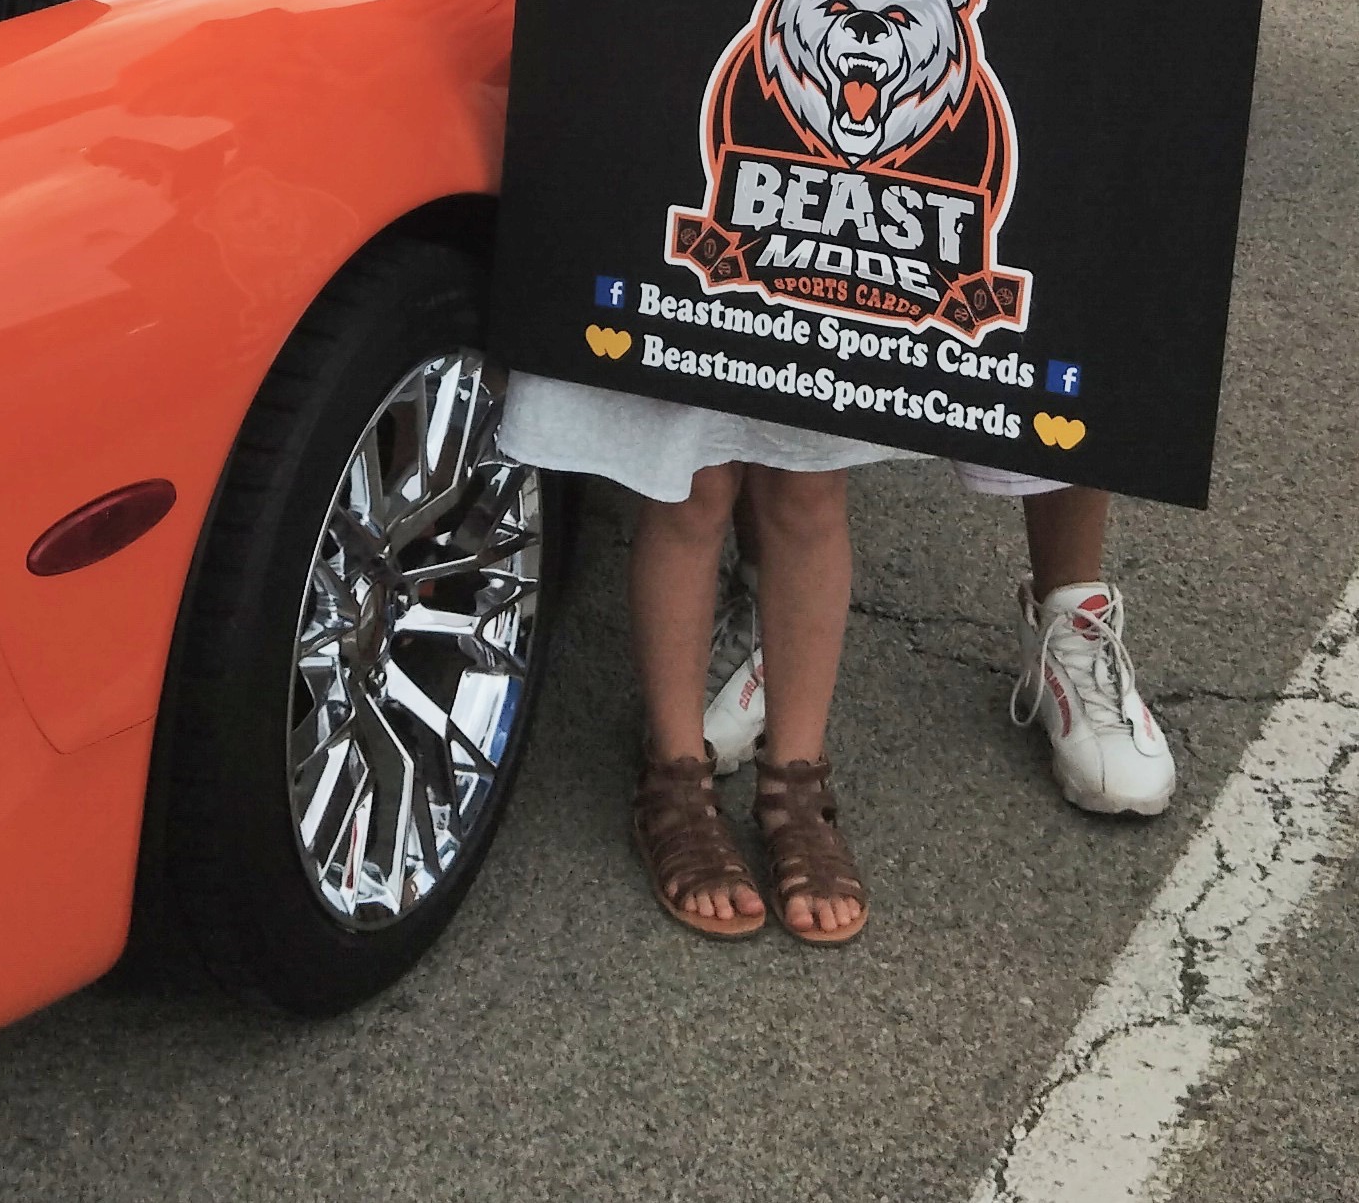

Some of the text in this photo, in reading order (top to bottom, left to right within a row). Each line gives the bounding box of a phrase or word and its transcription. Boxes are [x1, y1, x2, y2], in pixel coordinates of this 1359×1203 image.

[731, 160, 975, 265] BEAST
[755, 234, 941, 302] MODE
[774, 277, 922, 316] SPORTS CARDS
[638, 283, 810, 345] Beastmode
[818, 315, 928, 370] Sports
[936, 339, 1035, 389] Cards
[641, 334, 1022, 440] BeastmodeSportsCards
